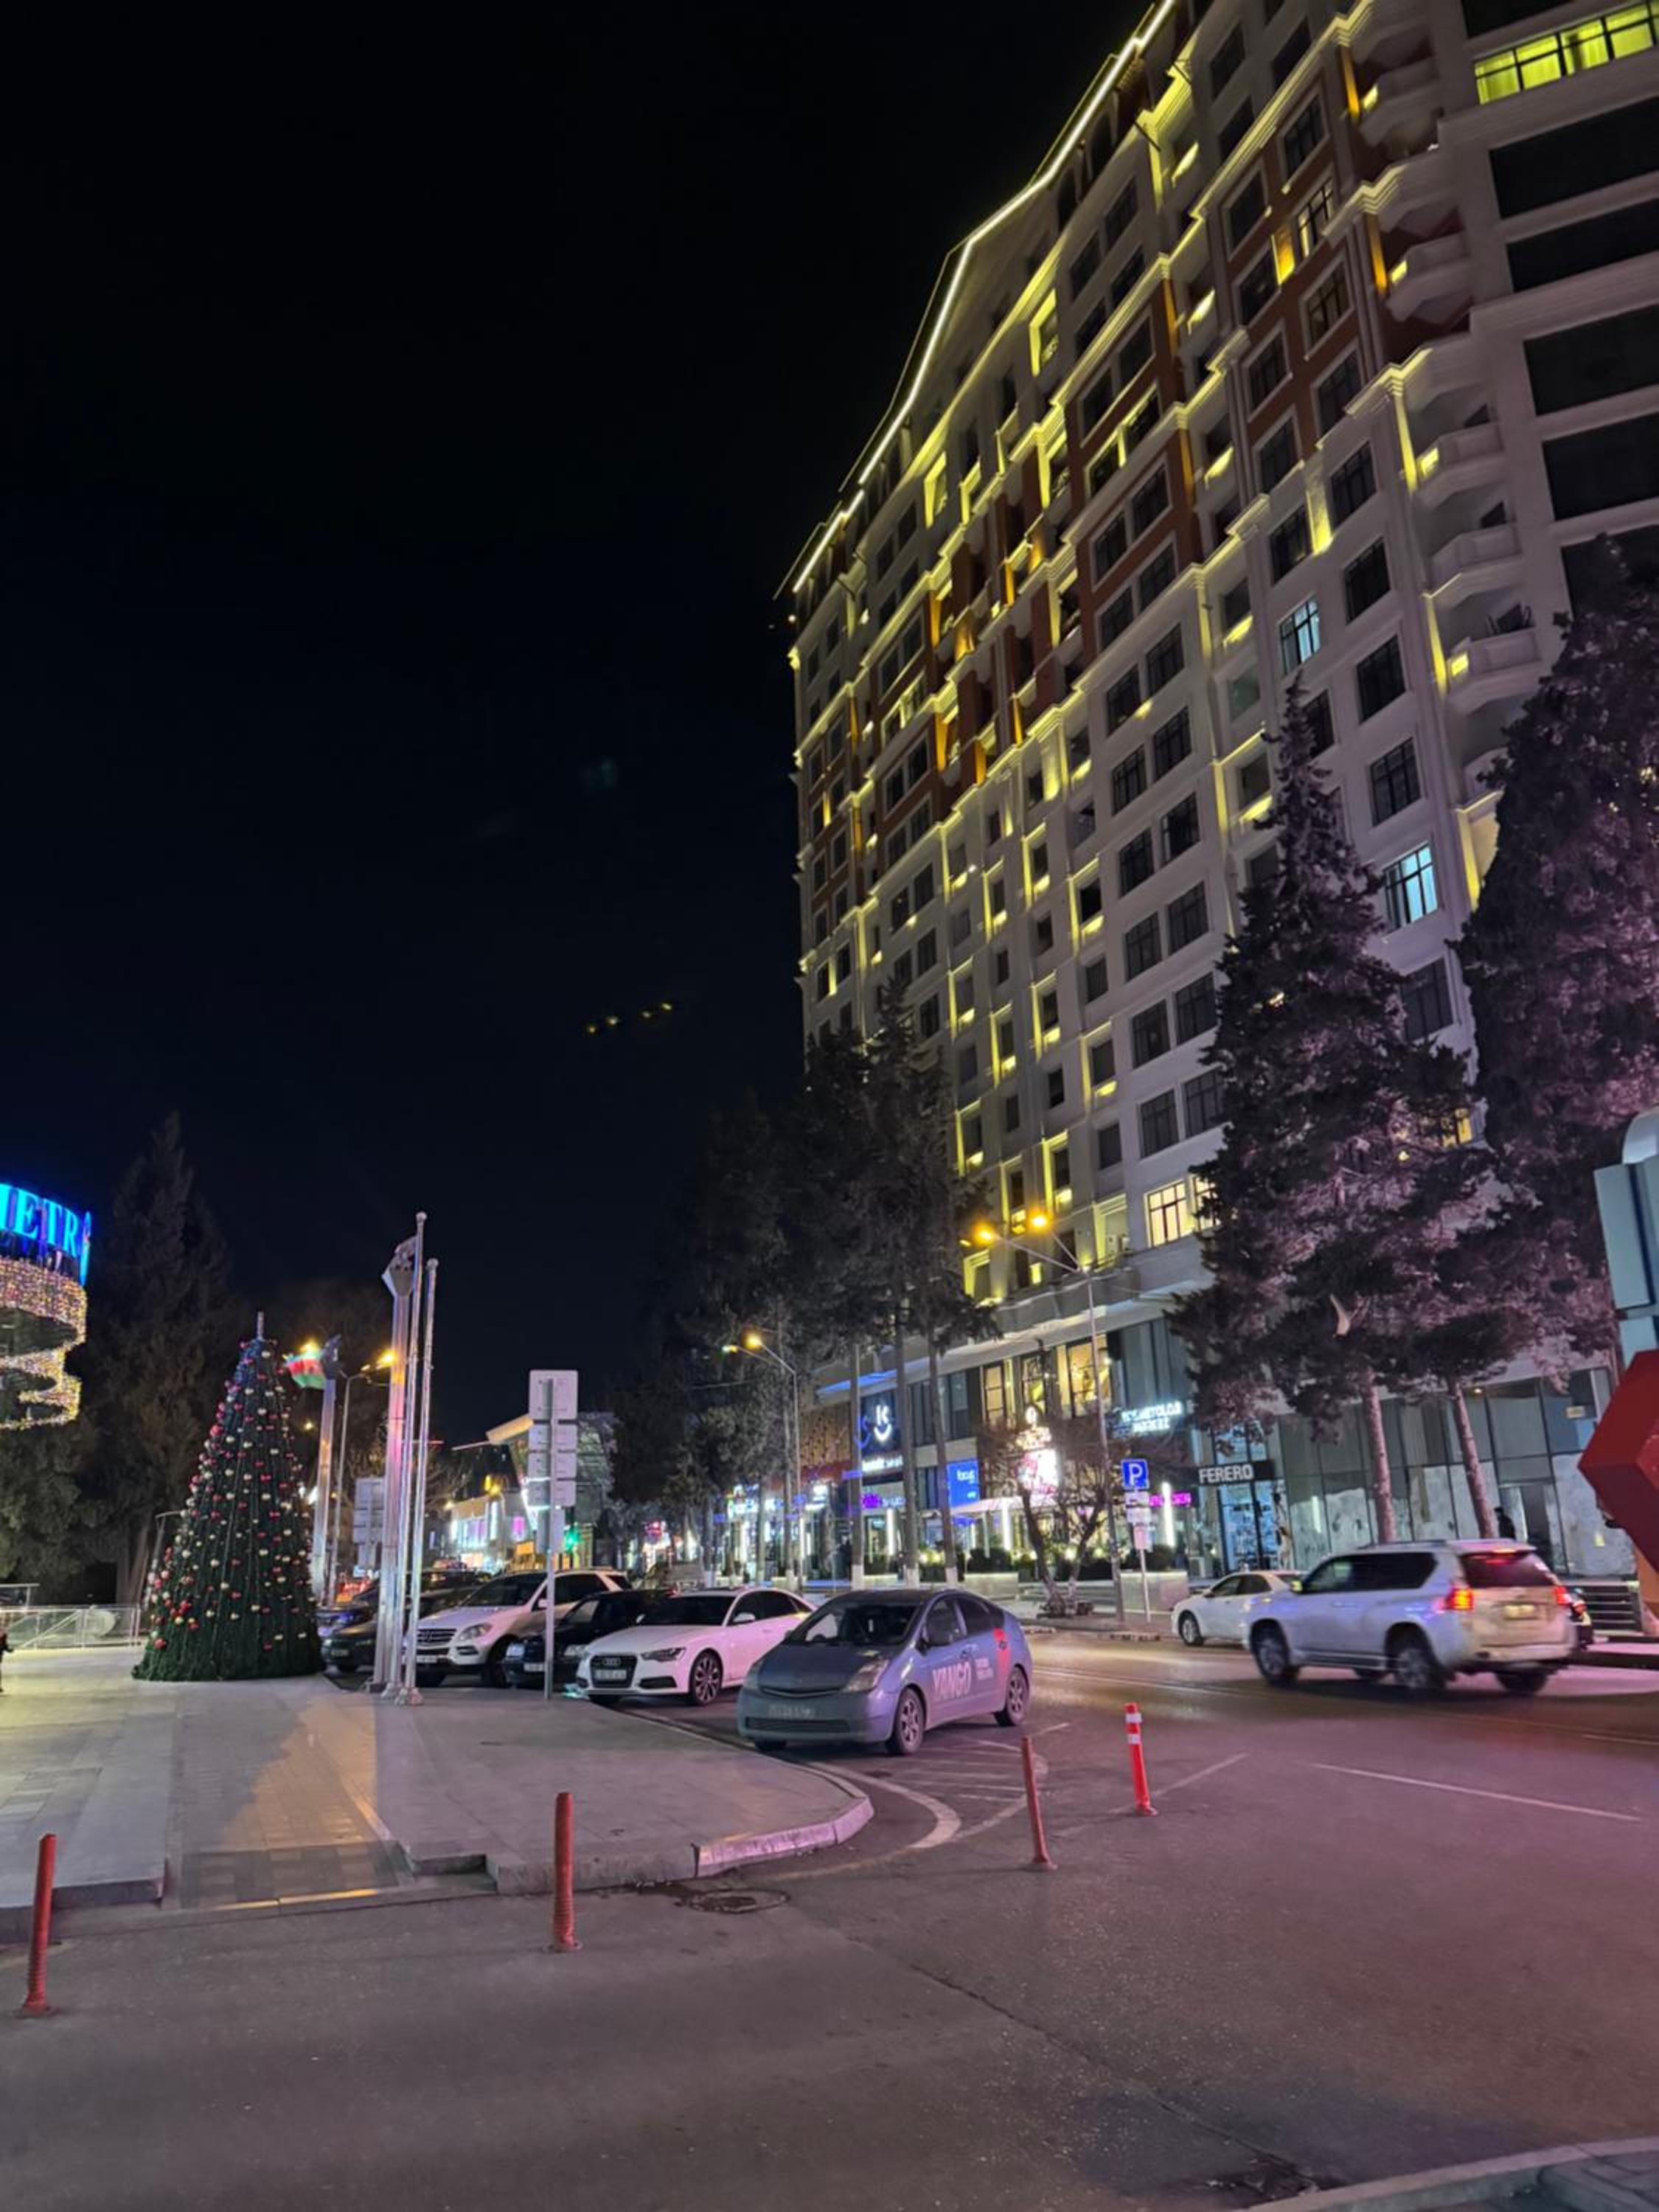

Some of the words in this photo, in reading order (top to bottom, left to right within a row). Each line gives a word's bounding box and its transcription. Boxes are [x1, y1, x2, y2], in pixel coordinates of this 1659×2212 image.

[1128, 1464, 1143, 1486] P
[1198, 1464, 1254, 1484] FERERO
[932, 1661, 971, 1699] YANGO
